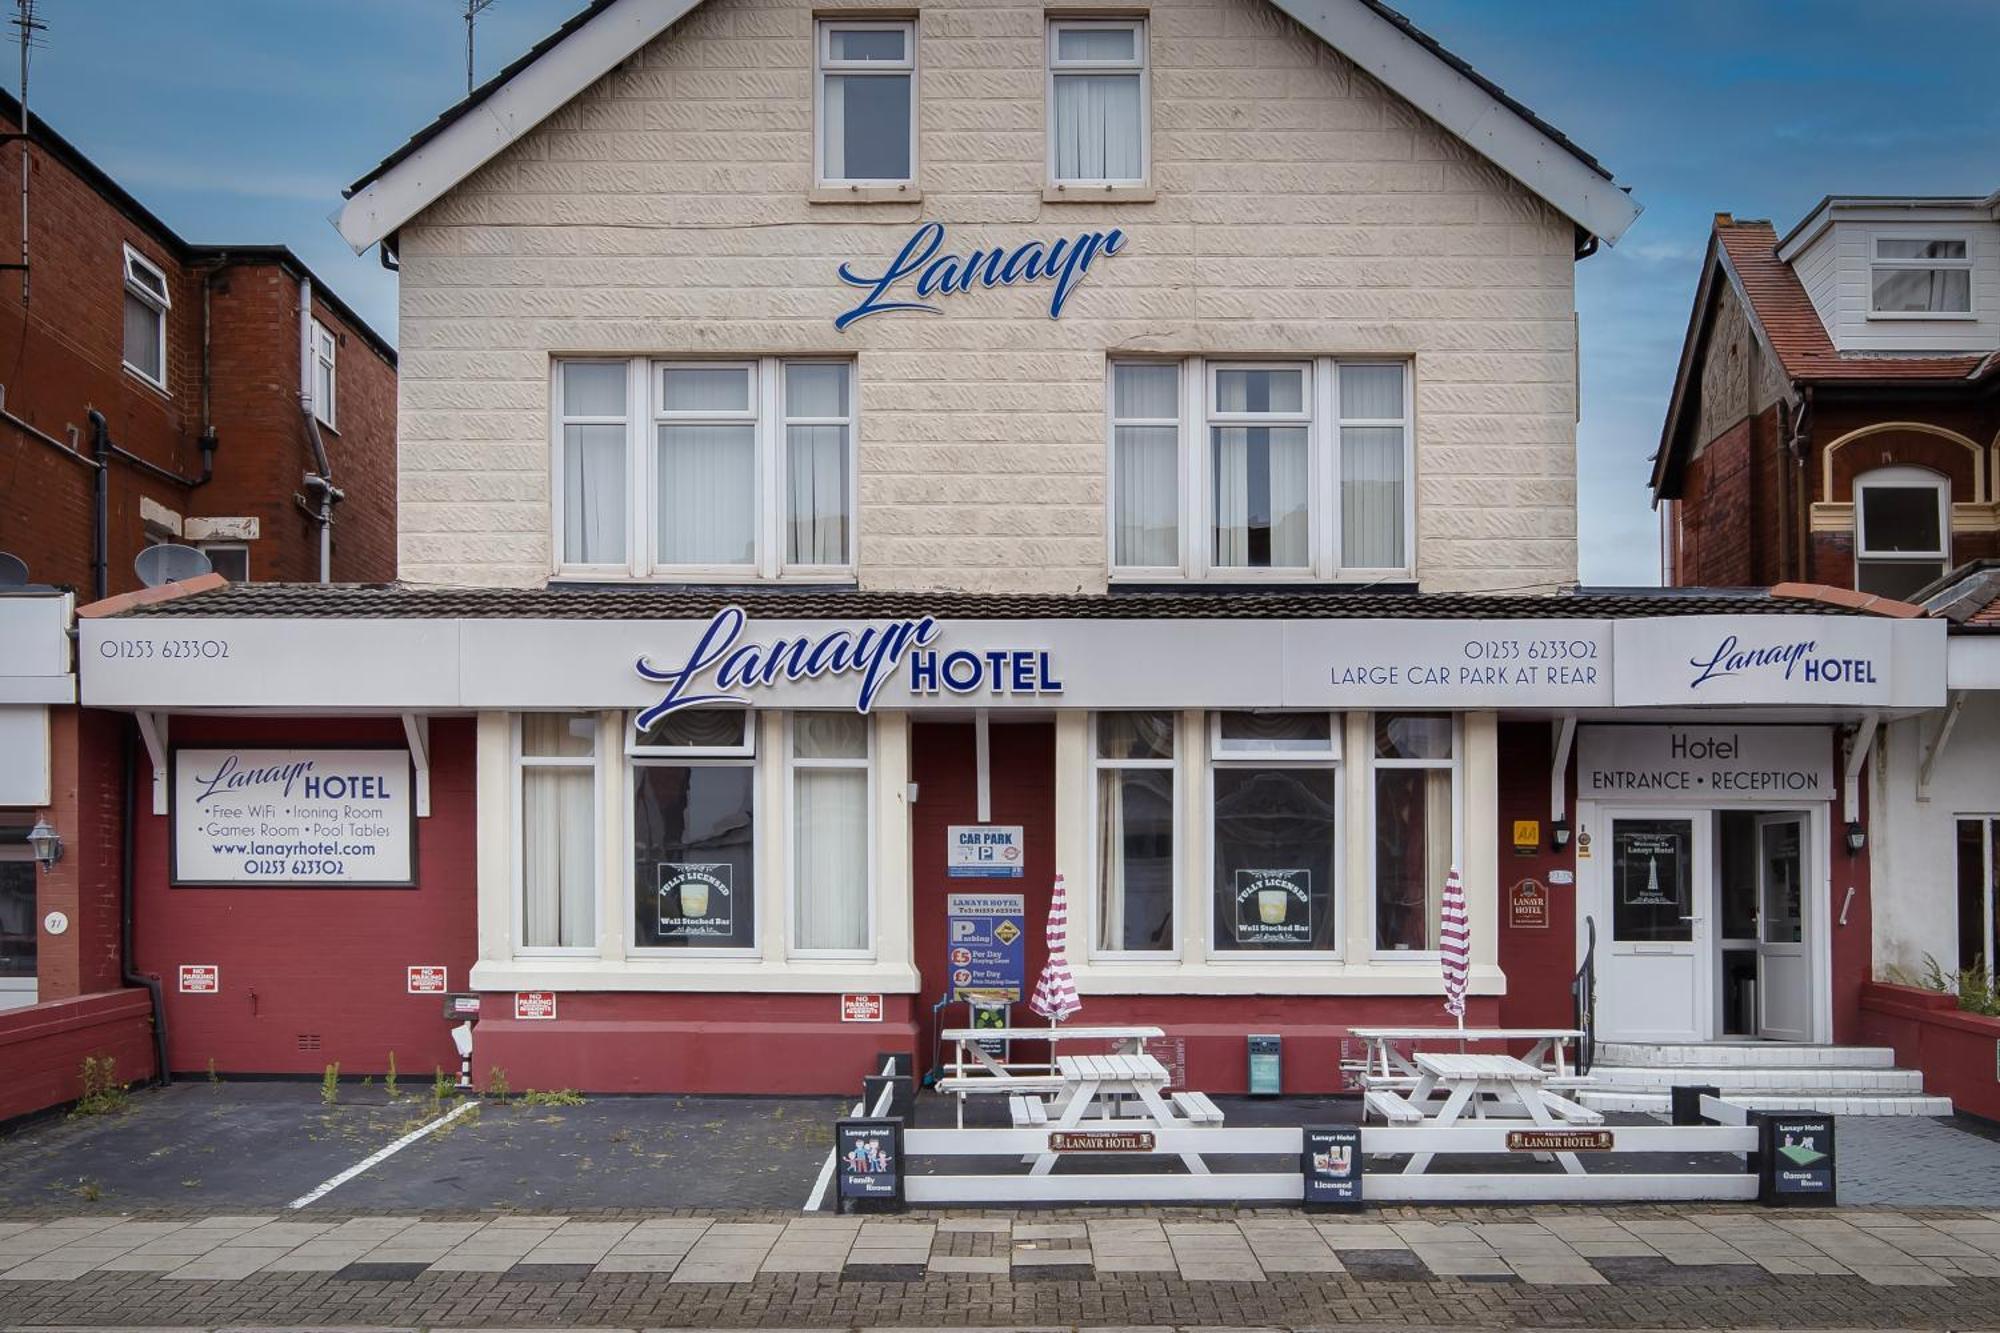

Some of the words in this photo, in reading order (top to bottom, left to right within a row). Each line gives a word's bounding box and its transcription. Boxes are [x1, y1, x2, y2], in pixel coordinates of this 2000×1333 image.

[834, 222, 1129, 333] Lanayr
[100, 640, 153, 658] 01253
[162, 640, 229, 658] 623302
[1464, 641, 1520, 659] 01253
[1528, 641, 1598, 659] 623302
[635, 607, 941, 732] Lanayr
[910, 650, 1063, 693] HOTEL
[1690, 635, 1816, 689] Lanayr
[1805, 659, 1877, 684] HOTEL
[1331, 666, 1399, 685] LARGE
[1407, 666, 1450, 685] CAR
[1460, 666, 1508, 685] PARK
[1516, 666, 1539, 685] AT
[1547, 666, 1597, 685] REAR
[1671, 734, 1738, 759] Hotel
[196, 755, 313, 803] Lanayr
[305, 776, 390, 799] HOTEL
[1592, 771, 1690, 790] ENTRANCE
[1712, 771, 1818, 790] RECEPTION
[212, 805, 242, 818] Free
[248, 804, 276, 818] WiFi
[294, 805, 338, 821] Ironing
[344, 805, 383, 818] Room
[206, 824, 255, 837] Games
[261, 823, 300, 837] Room
[314, 823, 343, 837] Pool
[350, 823, 390, 837] Tables
[960, 833, 981, 845] CAR
[984, 833, 1013, 845] PARK
[212, 842, 376, 858] www.lanayrhotel.com
[244, 860, 286, 874] 01253
[292, 860, 344, 875] 623302
[1237, 881, 1263, 903] FULLY
[1265, 879, 1308, 903] LICENSED
[1516, 906, 1542, 914] HOTEL
[1067, 1138, 1103, 1148] LANAYR
[1105, 1138, 1137, 1148] HOTEL
[1524, 1137, 1561, 1147] LANAYR
[1563, 1137, 1596, 1147] HOTEL
[849, 1176, 875, 1184] Family
